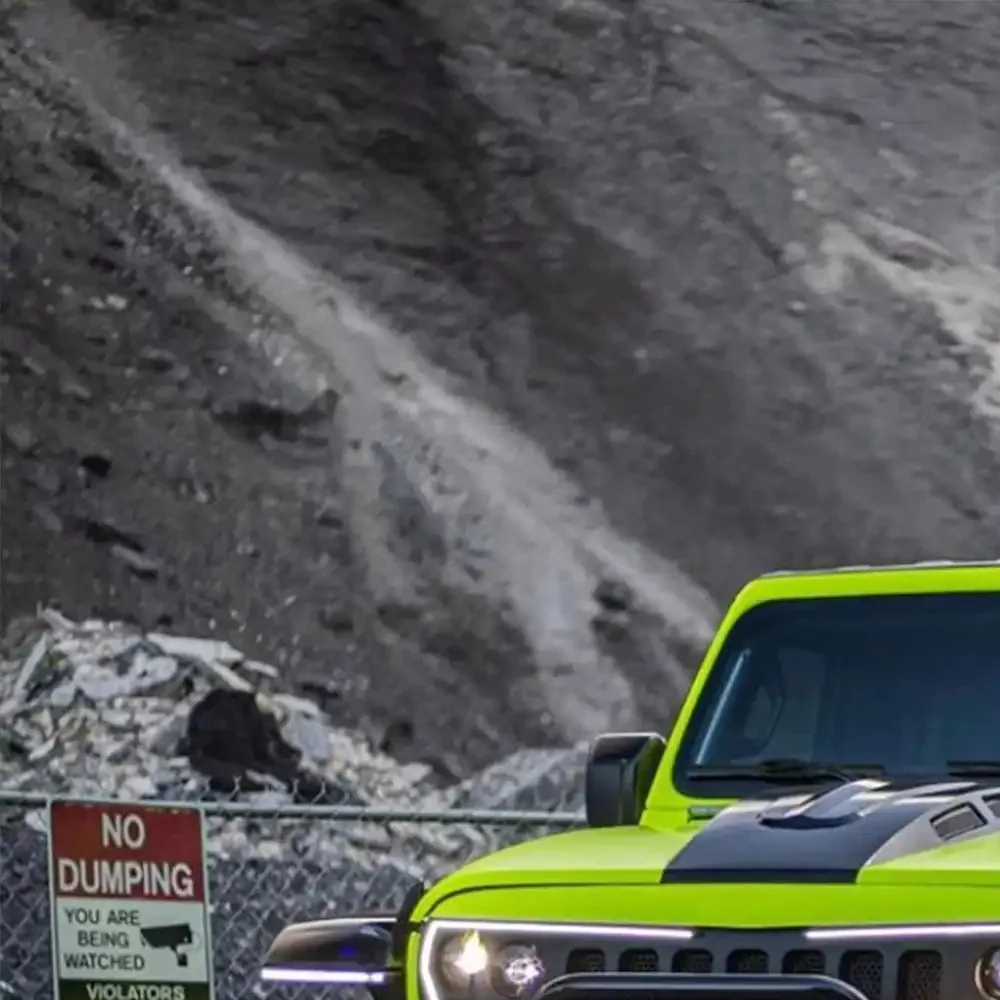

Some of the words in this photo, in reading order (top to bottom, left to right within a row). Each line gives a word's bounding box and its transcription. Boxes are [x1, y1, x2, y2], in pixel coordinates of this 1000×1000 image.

[101, 813, 146, 849] NO
[58, 858, 194, 896] DUMPING
[64, 907, 101, 925] YOU
[107, 910, 141, 926] ARE
[77, 931, 130, 948] BEING
[64, 953, 145, 971] WATCHED
